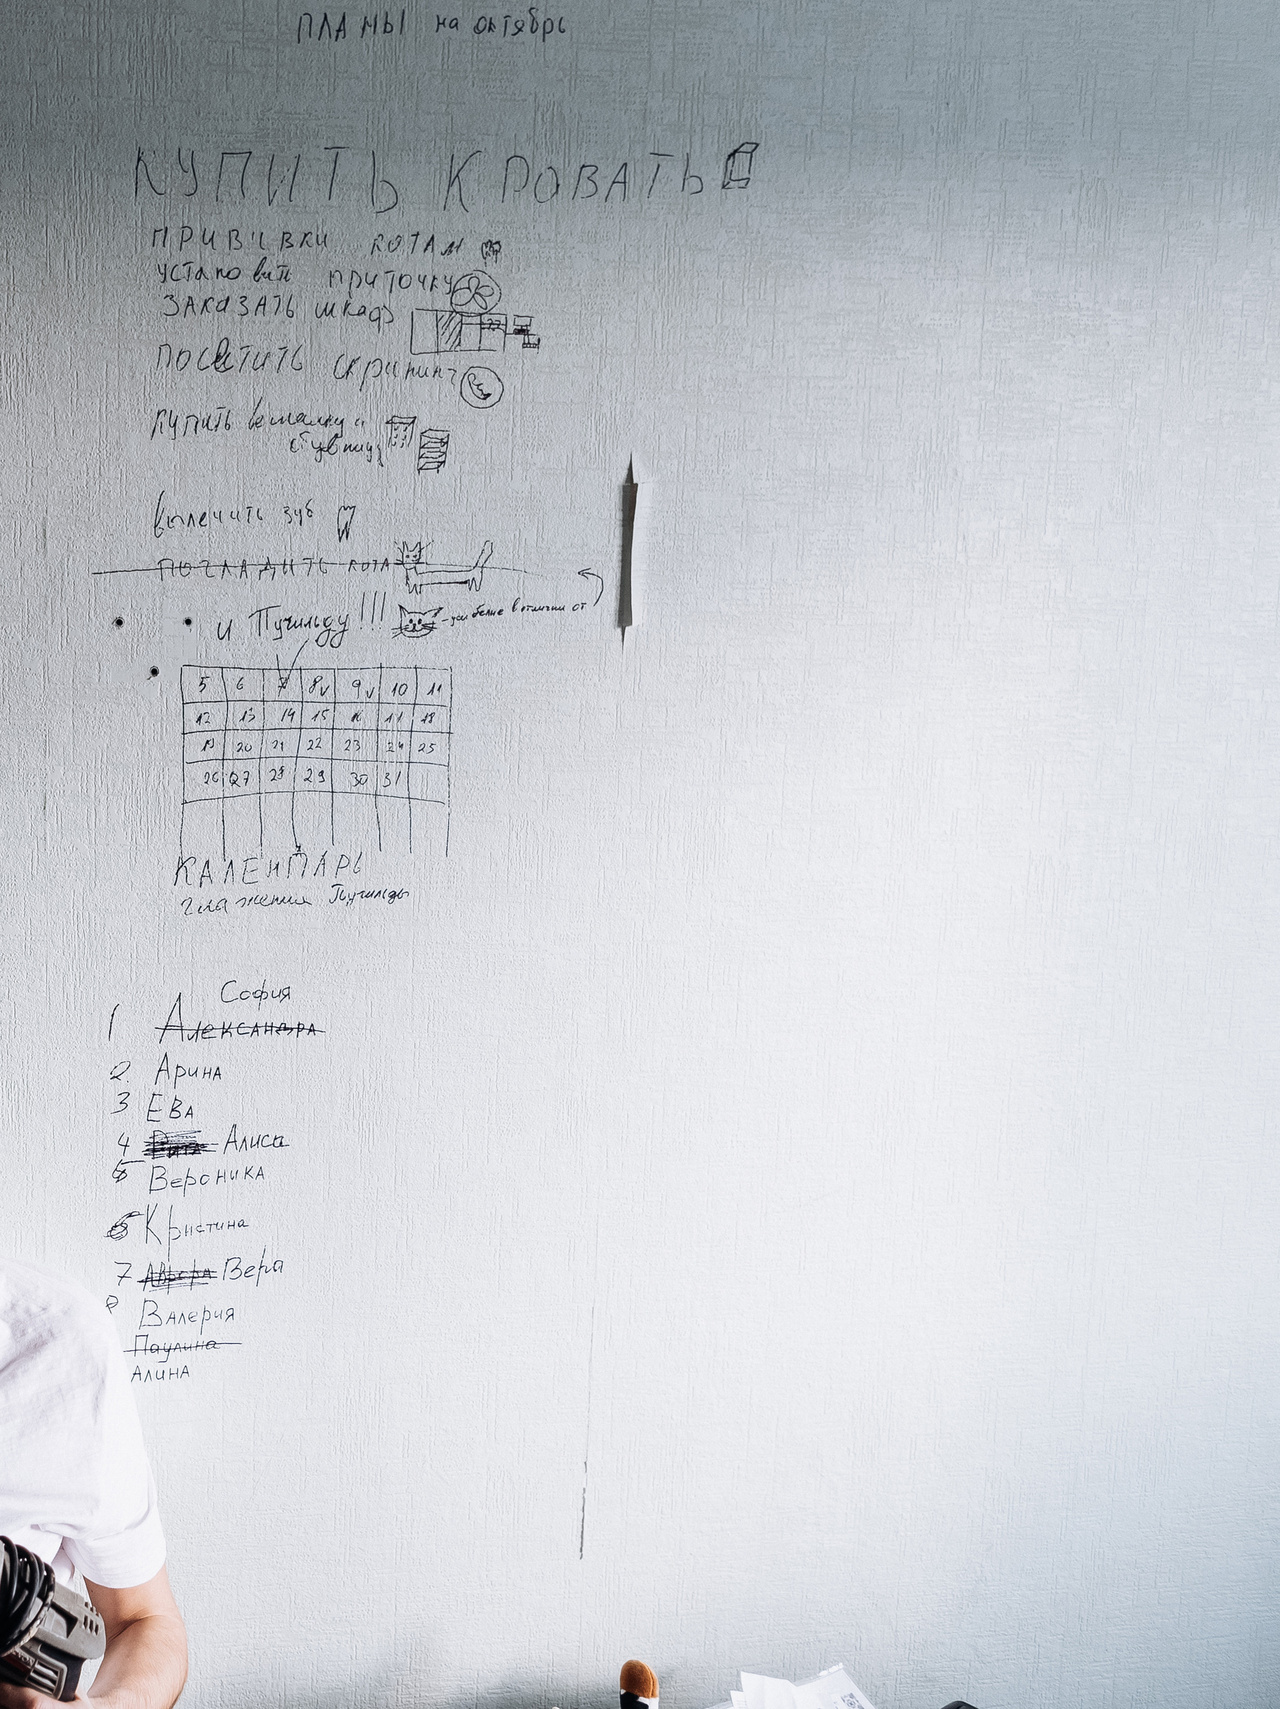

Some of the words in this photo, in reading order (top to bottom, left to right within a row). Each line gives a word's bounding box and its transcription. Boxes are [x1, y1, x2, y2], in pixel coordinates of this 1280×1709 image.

[435, 14, 460, 33] на
[473, 7, 566, 42] октябрь
[133, 146, 400, 214] КУПИТЬ
[443, 150, 704, 213] КРОВАТЬ
[199, 676, 211, 693] 5
[308, 675, 323, 694] 8
[351, 679, 361, 699] 9
[391, 682, 408, 697] 10
[426, 682, 442, 695] 11
[196, 711, 211, 725] 12
[280, 707, 296, 723] 14
[311, 708, 330, 722] 15
[236, 741, 252, 752] 20
[306, 736, 322, 751] 22
[344, 738, 361, 751] 23
[417, 742, 437, 754] 25
[229, 770, 250, 788] 27
[303, 767, 326, 783] 29
[350, 771, 369, 787] 30
[382, 770, 402, 788] 31
[220, 979, 292, 1011] София
[110, 1091, 131, 1115] 3
[117, 1132, 131, 1157] 4
[222, 1123, 291, 1155] Алиса
[145, 1203, 250, 1262] Кристина
[113, 1260, 133, 1287] 7
[222, 1245, 284, 1287] Вера
